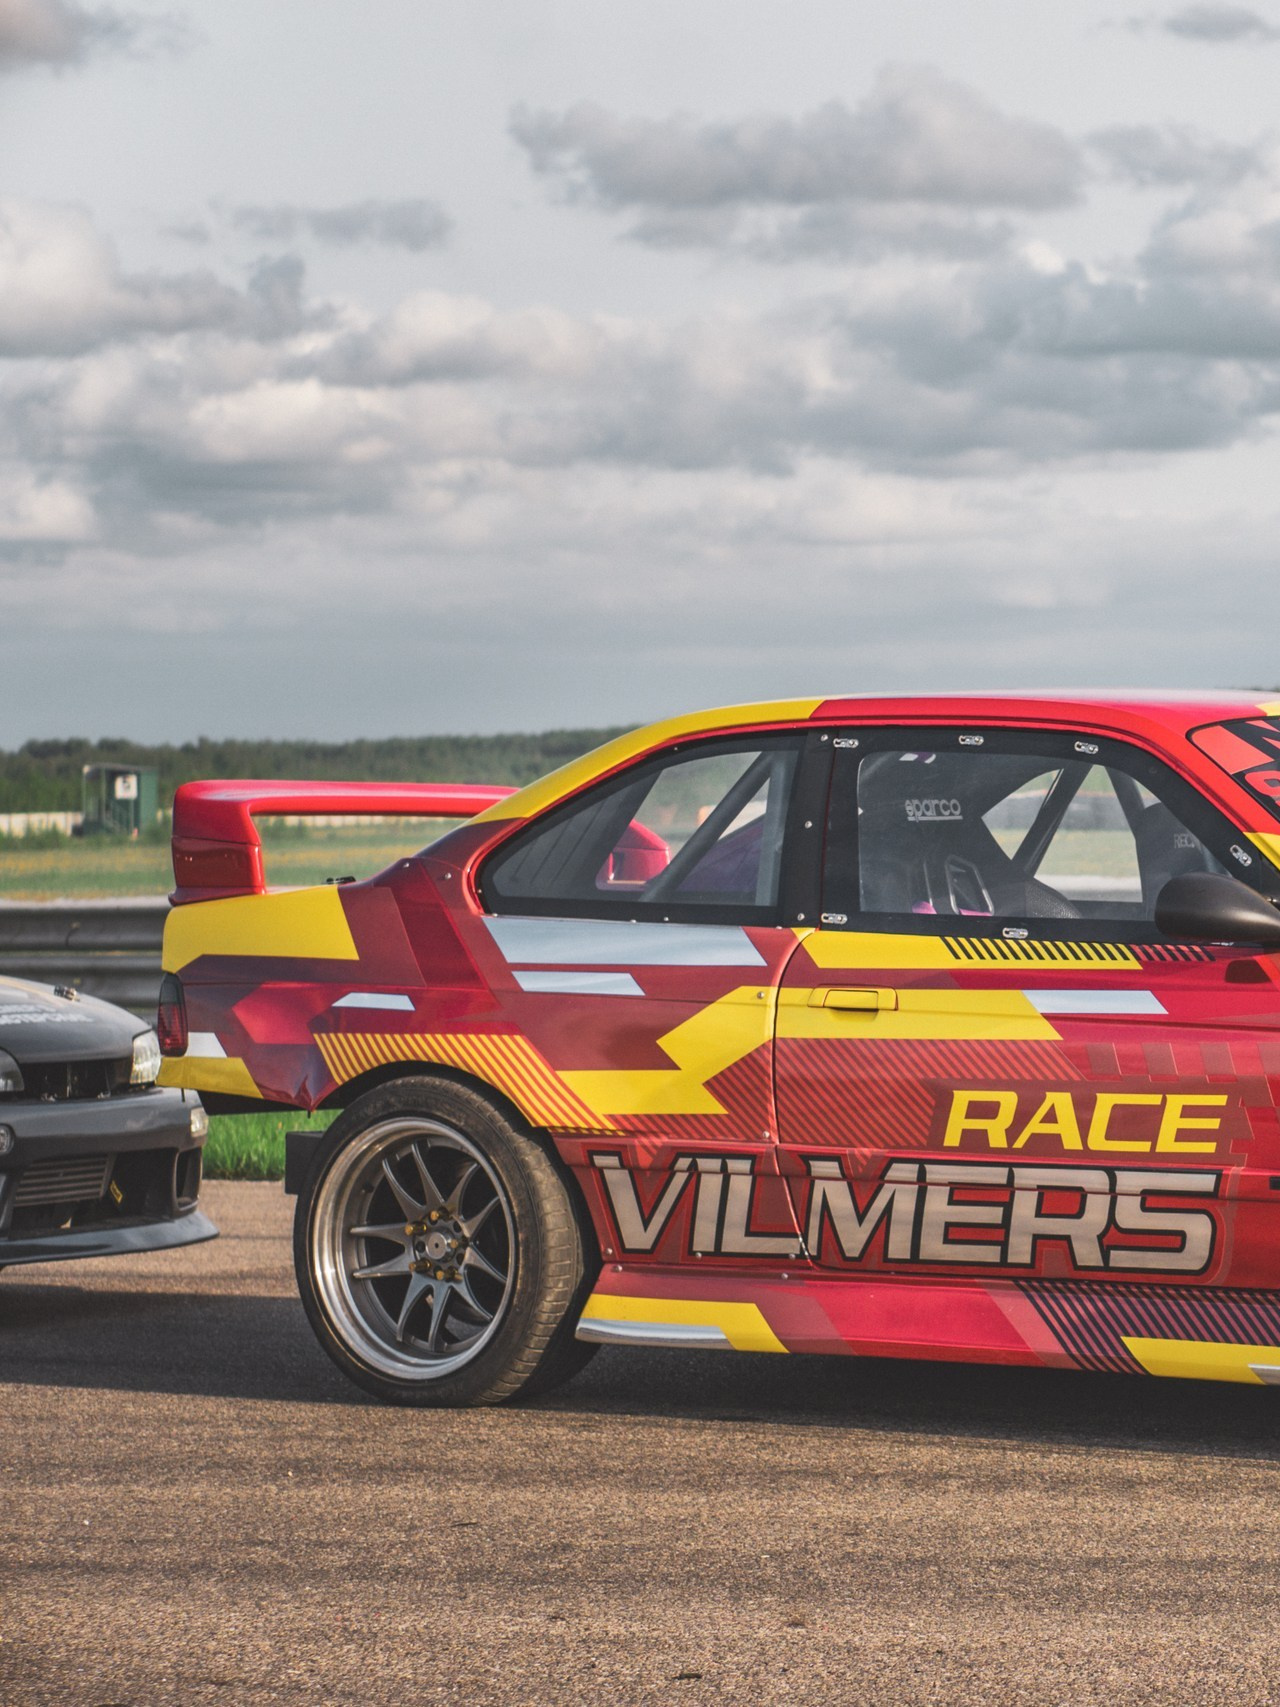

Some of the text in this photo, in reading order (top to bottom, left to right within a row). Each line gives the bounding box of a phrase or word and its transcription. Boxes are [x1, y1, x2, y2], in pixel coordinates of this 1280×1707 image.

[904, 798, 962, 822] sparco
[943, 1089, 1227, 1153] RACE
[589, 1152, 1225, 1272] VILMERS
